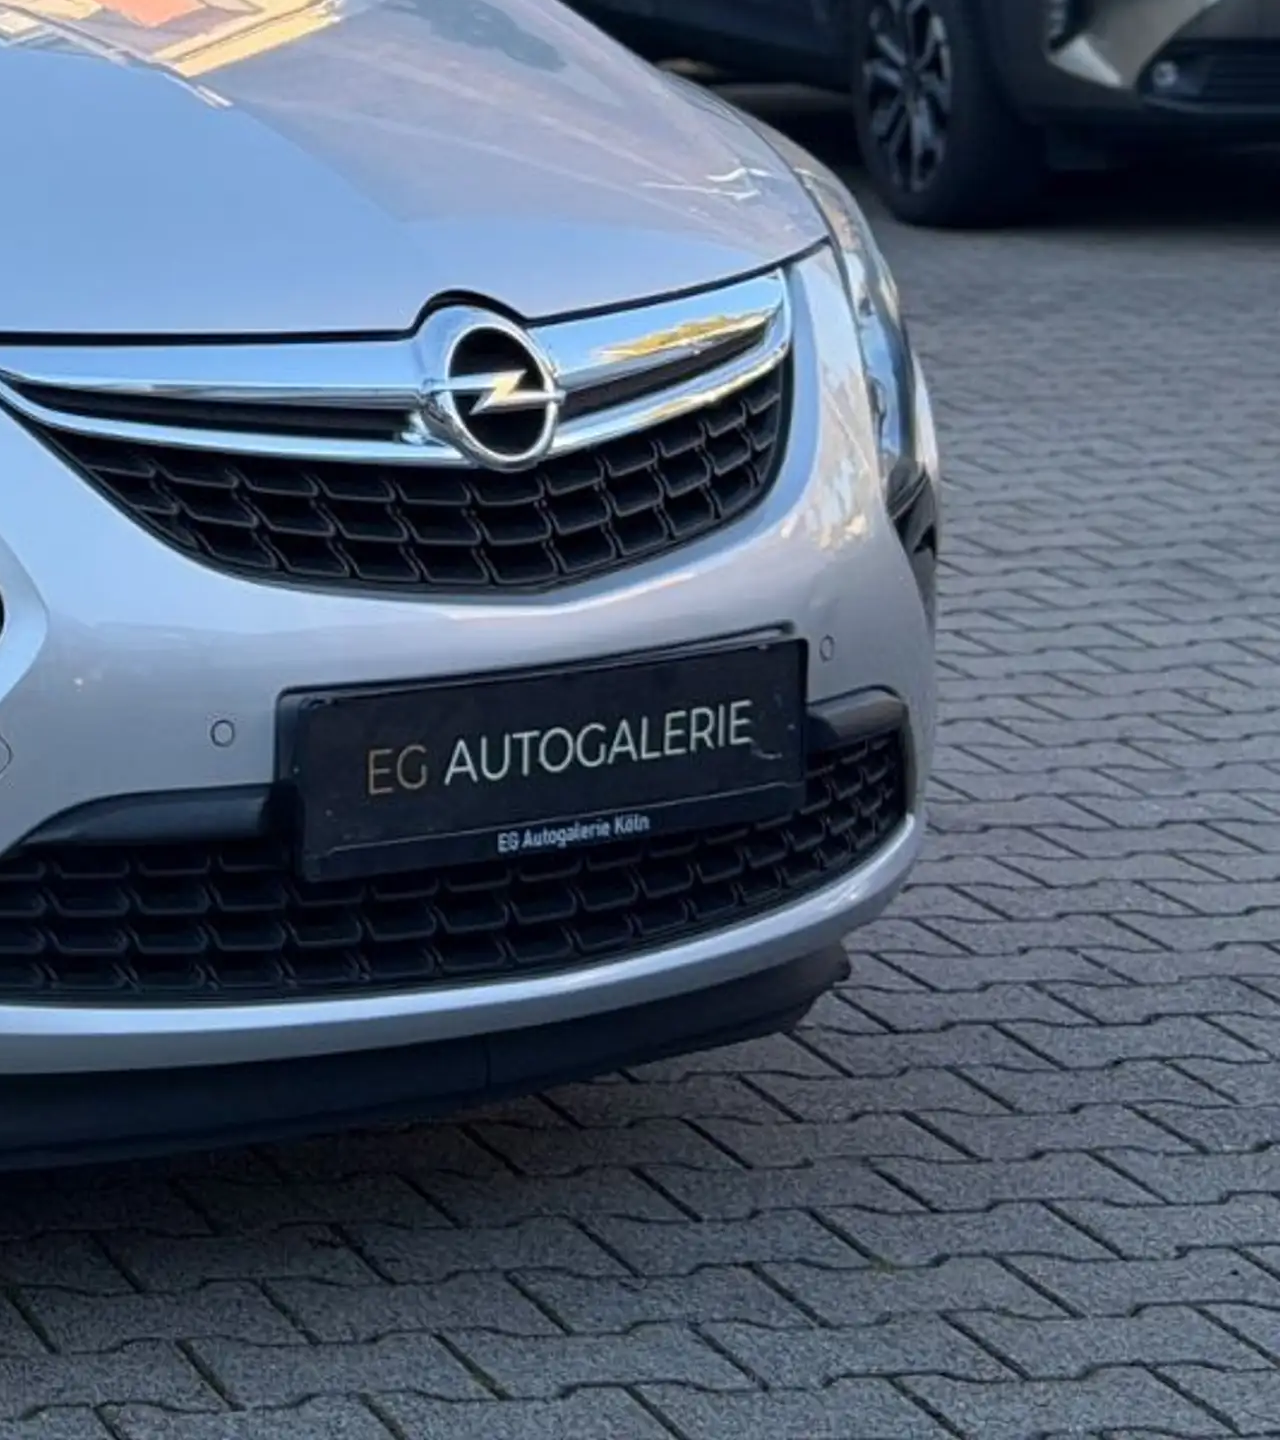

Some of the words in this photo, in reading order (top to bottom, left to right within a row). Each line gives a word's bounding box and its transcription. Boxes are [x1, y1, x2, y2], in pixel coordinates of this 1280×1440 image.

[368, 744, 428, 796] EG
[443, 699, 755, 786] AUTOGALERIE
[497, 831, 519, 853] EG
[521, 818, 610, 849] Autogalerie
[614, 813, 651, 835] Köln
